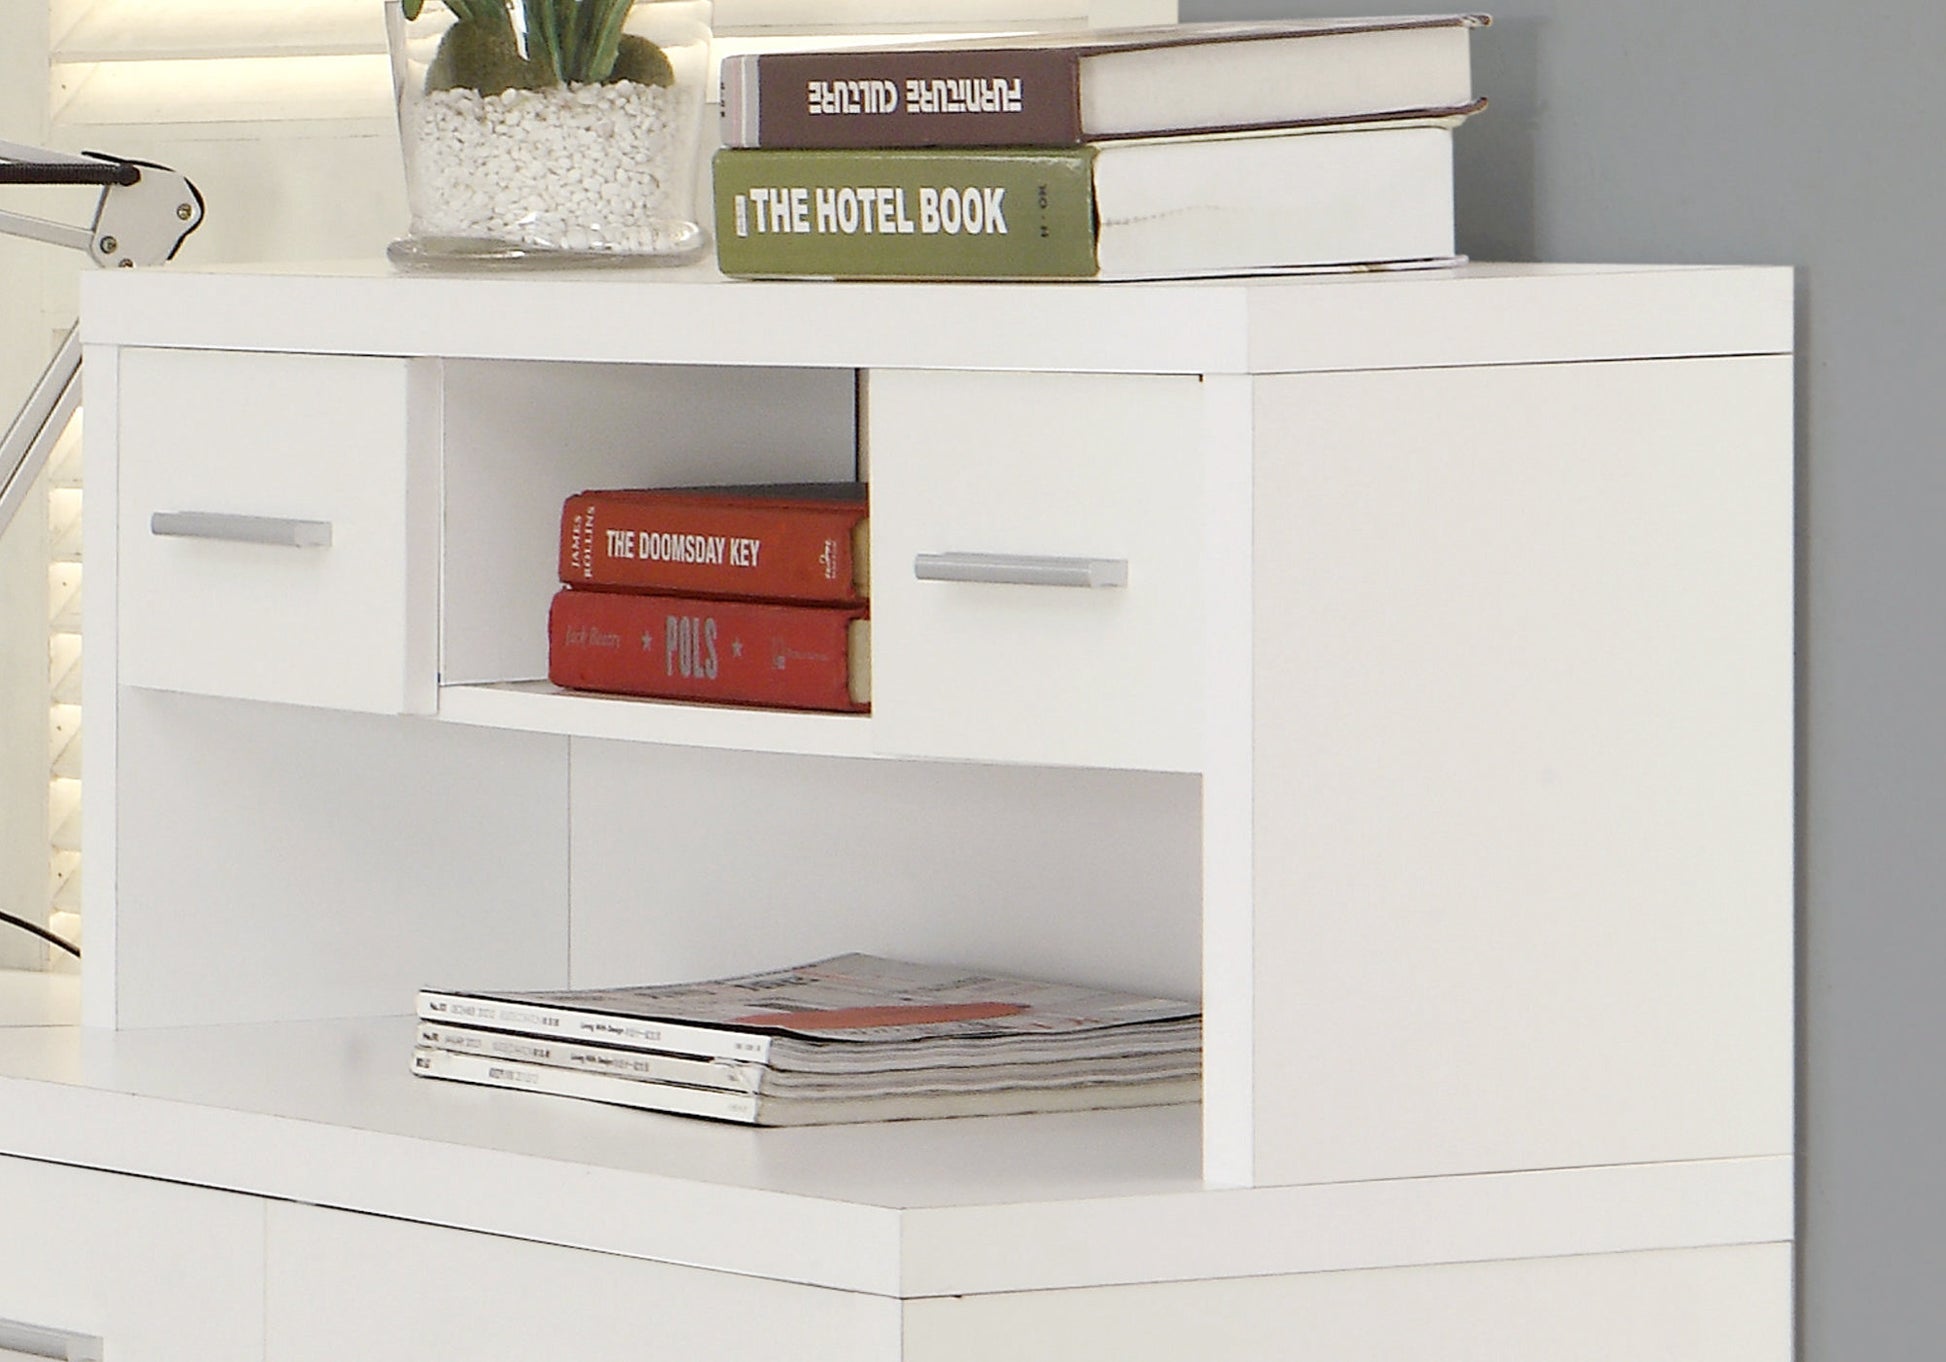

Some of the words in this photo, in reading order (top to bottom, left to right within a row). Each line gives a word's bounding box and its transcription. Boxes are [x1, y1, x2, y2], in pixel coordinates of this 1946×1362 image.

[807, 80, 899, 114] CULTURE
[749, 187, 812, 235] THE
[816, 187, 914, 235] HOTEL
[919, 188, 1008, 236] BOOK
[571, 515, 583, 568] JAMES
[583, 506, 596, 579] ROLLINS
[605, 529, 635, 559] THE
[638, 531, 726, 566] DOOMSDAY
[729, 537, 761, 568] KEY
[665, 615, 718, 680] POLS
